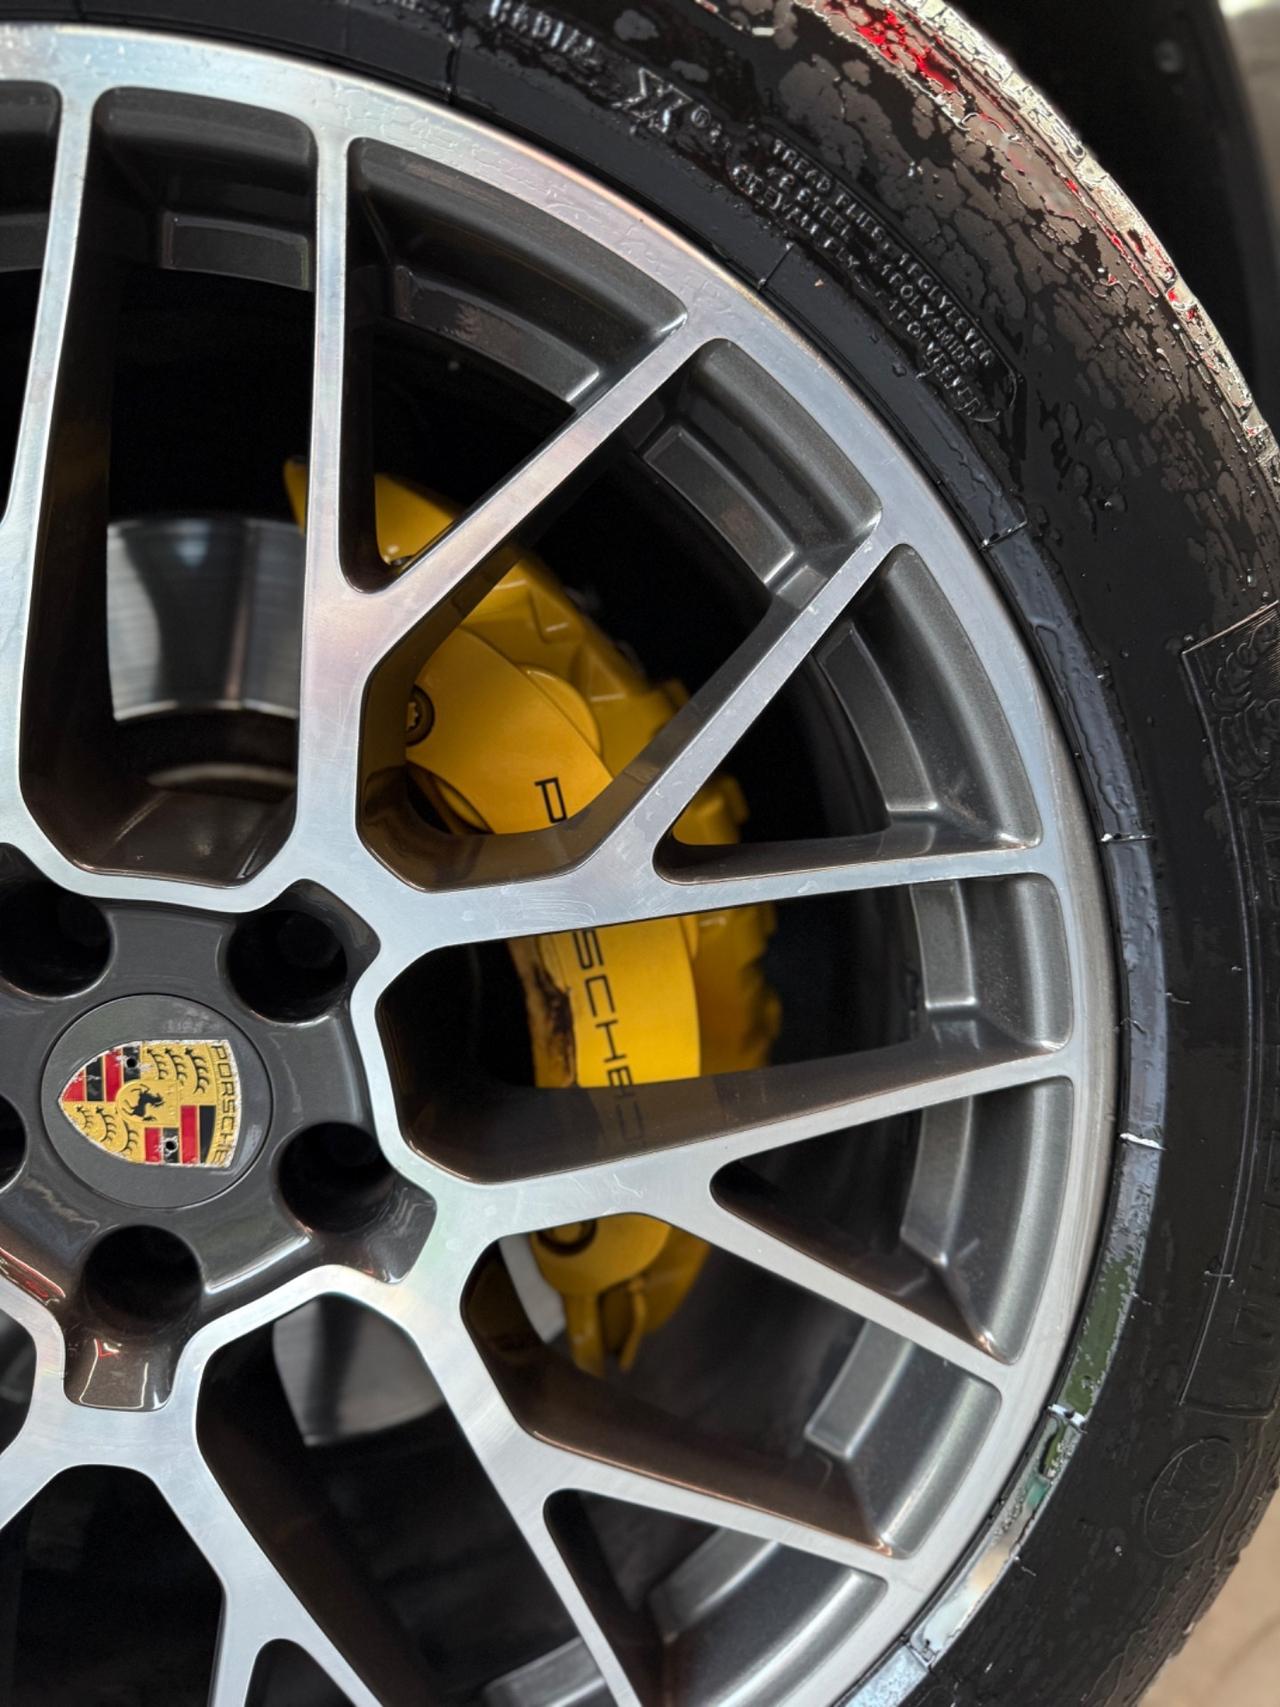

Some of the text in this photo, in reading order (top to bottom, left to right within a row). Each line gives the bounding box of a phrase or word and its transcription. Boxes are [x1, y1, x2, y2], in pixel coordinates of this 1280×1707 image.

[772, 138, 833, 195] TREAD
[796, 186, 851, 241] STEEL
[888, 272, 975, 372] POLYAMIDE
[211, 1044, 235, 1165] PORSCHE
